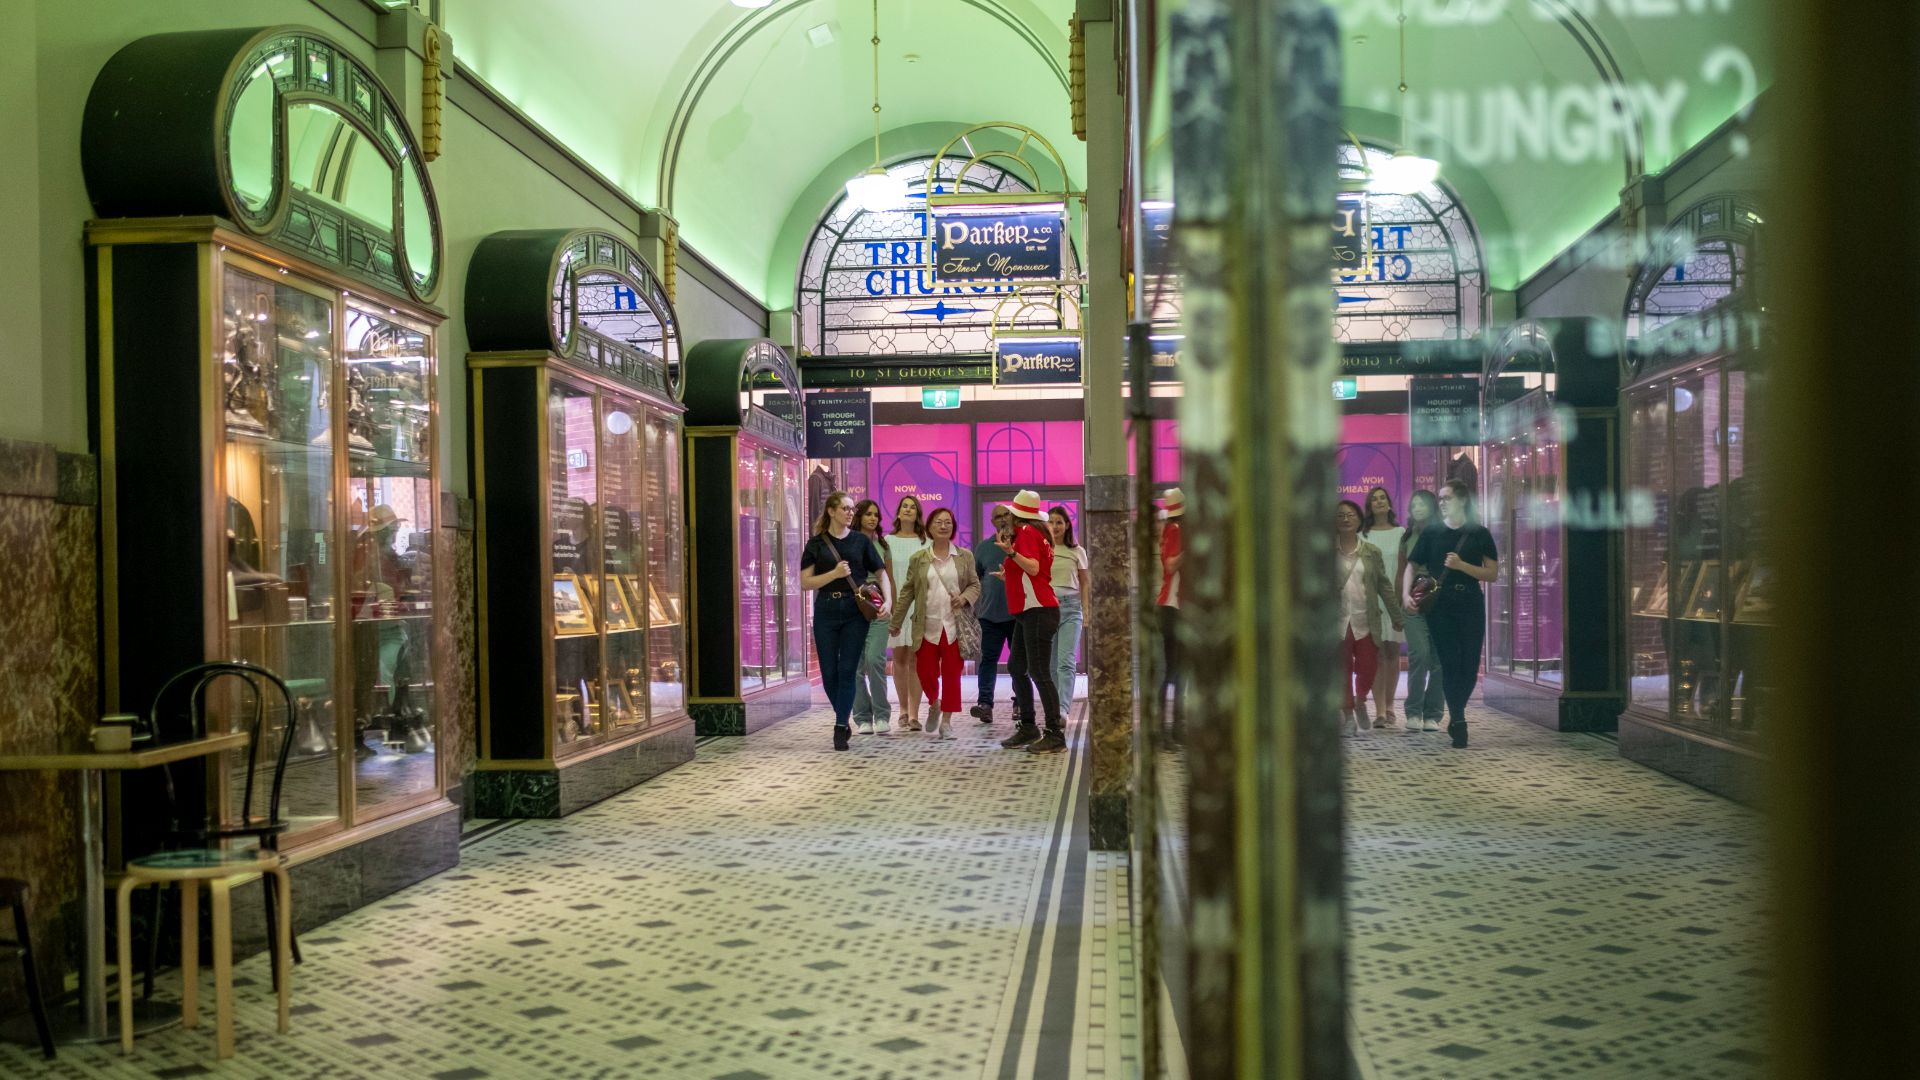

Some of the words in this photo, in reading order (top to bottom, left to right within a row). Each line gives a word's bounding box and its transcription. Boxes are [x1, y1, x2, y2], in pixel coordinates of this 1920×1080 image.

[1403, 78, 1690, 166] HUNGRY
[943, 257, 981, 274] Finest
[987, 252, 1050, 276] Menswear
[865, 269, 1014, 296] CHU
[850, 368, 865, 378] TO
[877, 367, 890, 377] ST
[821, 411, 856, 419] THROUGH
[833, 419, 866, 427] GEORGES
[894, 485, 916, 493] NOW
